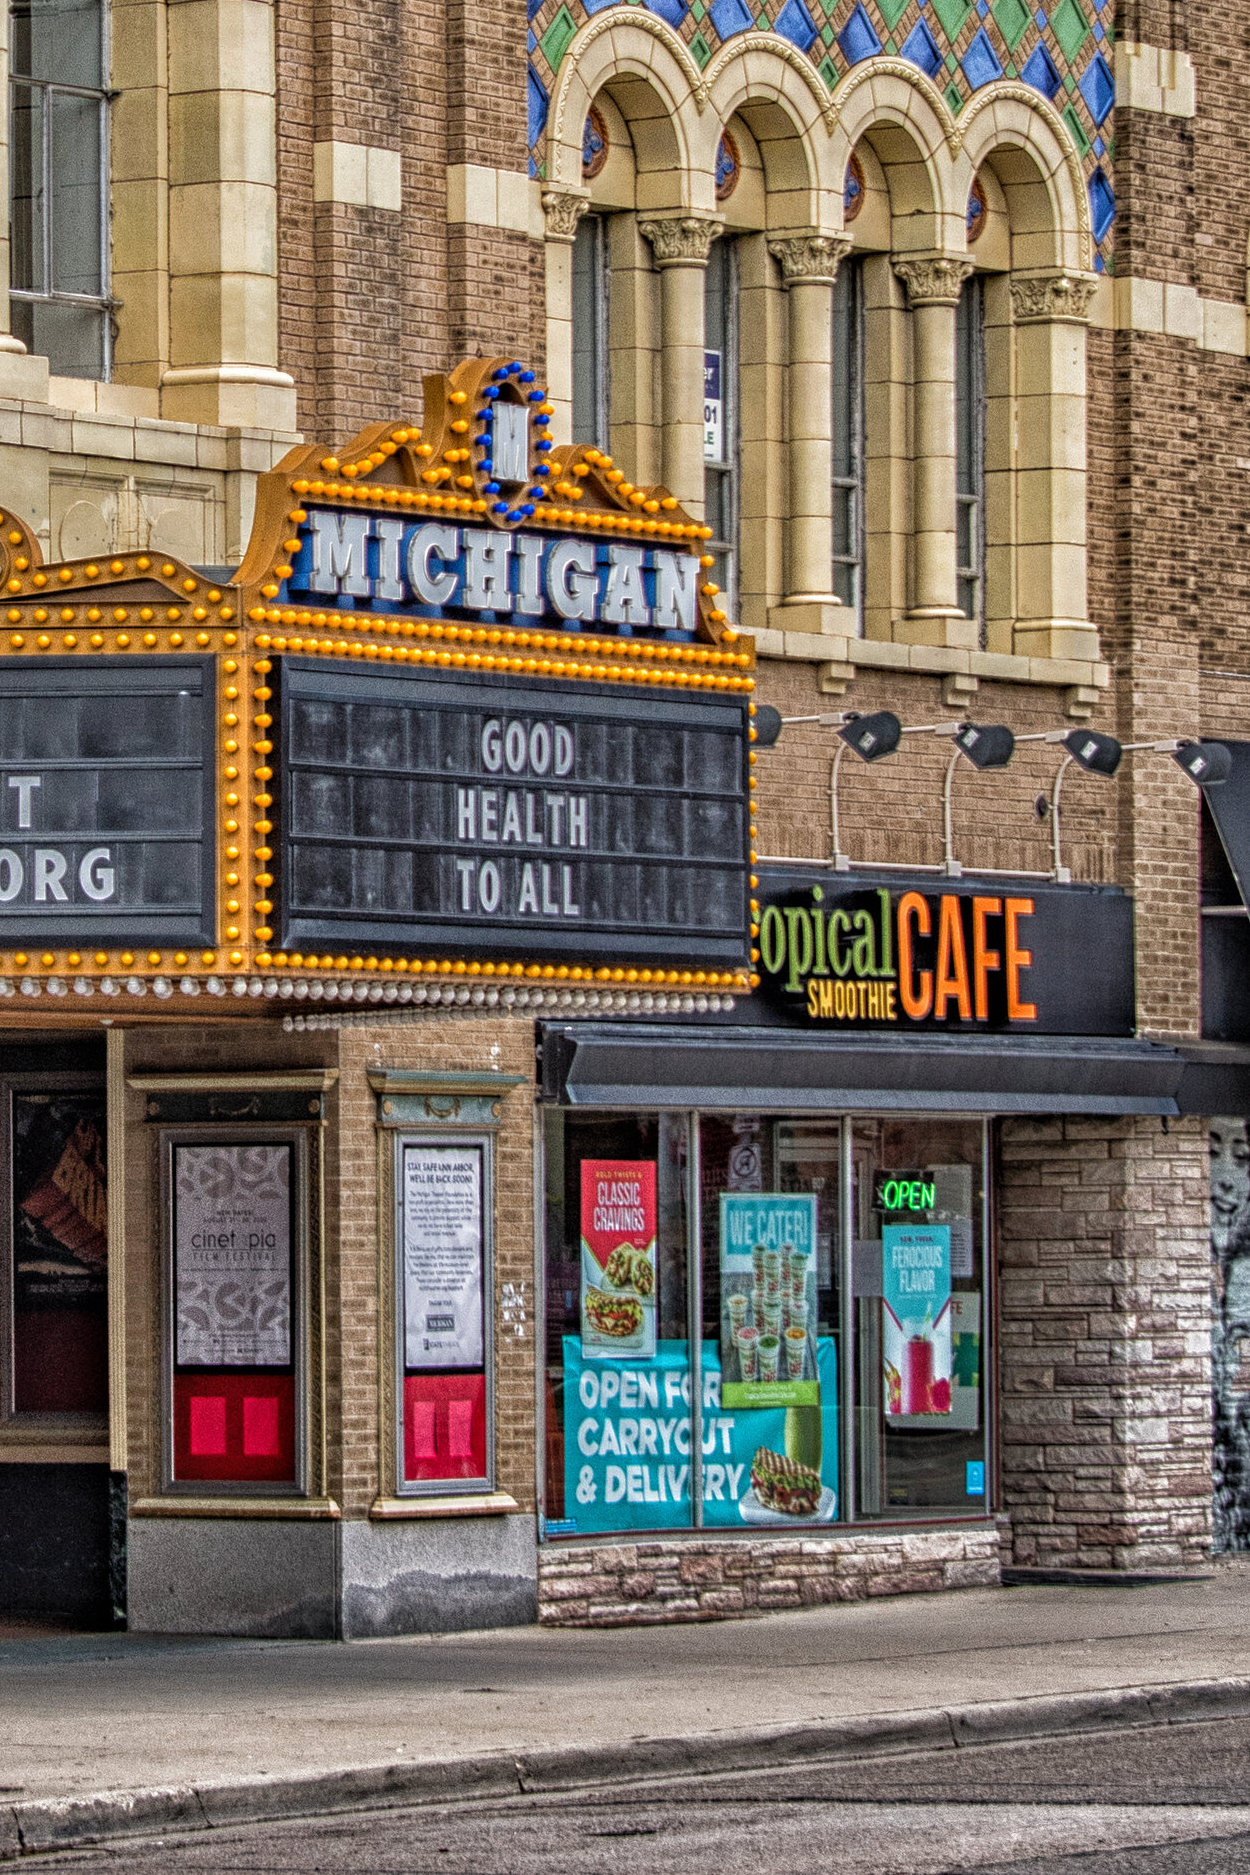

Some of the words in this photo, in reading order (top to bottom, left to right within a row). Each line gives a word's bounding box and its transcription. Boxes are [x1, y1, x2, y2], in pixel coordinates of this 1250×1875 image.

[309, 510, 700, 631] MICHIGAN
[481, 719, 575, 777] GOOD
[457, 788, 588, 847] HEALTH
[456, 859, 500, 913] TO
[519, 862, 580, 916] ALL
[897, 890, 1039, 1022] CAFE
[807, 978, 898, 1021] SMOOTHIE
[423, 1162, 437, 1172] SAFE
[597, 1182, 640, 1206] CLASSIC
[883, 1179, 936, 1211] OPEN
[593, 1207, 645, 1232] CRAVINGS
[729, 1209, 753, 1246] WE
[755, 1208, 809, 1246] CATER!
[892, 1245, 943, 1269] FEROCIOUS
[899, 1269, 935, 1293] FLAVOR
[578, 1370, 659, 1410] OPEN
[577, 1417, 735, 1457] CARRYOUT
[575, 1465, 598, 1505] &
